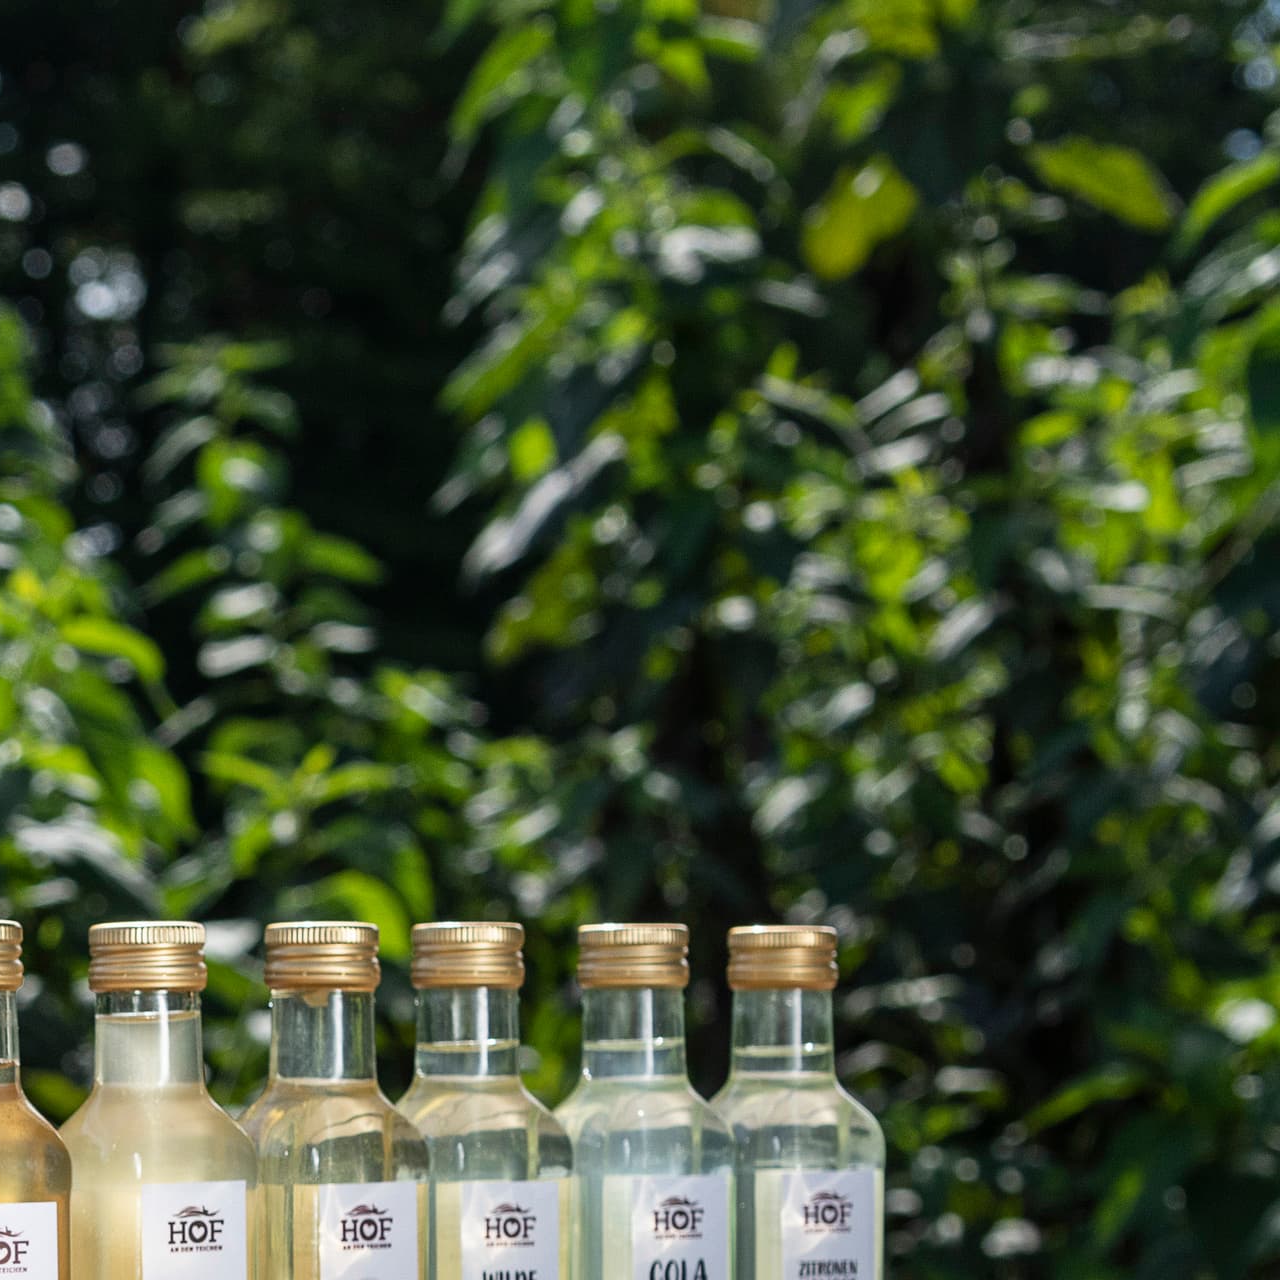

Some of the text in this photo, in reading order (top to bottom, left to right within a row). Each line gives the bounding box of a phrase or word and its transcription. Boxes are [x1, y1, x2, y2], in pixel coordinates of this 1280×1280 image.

[653, 1209, 704, 1232] HOF
[803, 1203, 854, 1225] HOF
[167, 1219, 225, 1244] HOF
[340, 1216, 394, 1242] HOF
[484, 1216, 537, 1240] HOF
[798, 1259, 858, 1277] ZITRONEN
